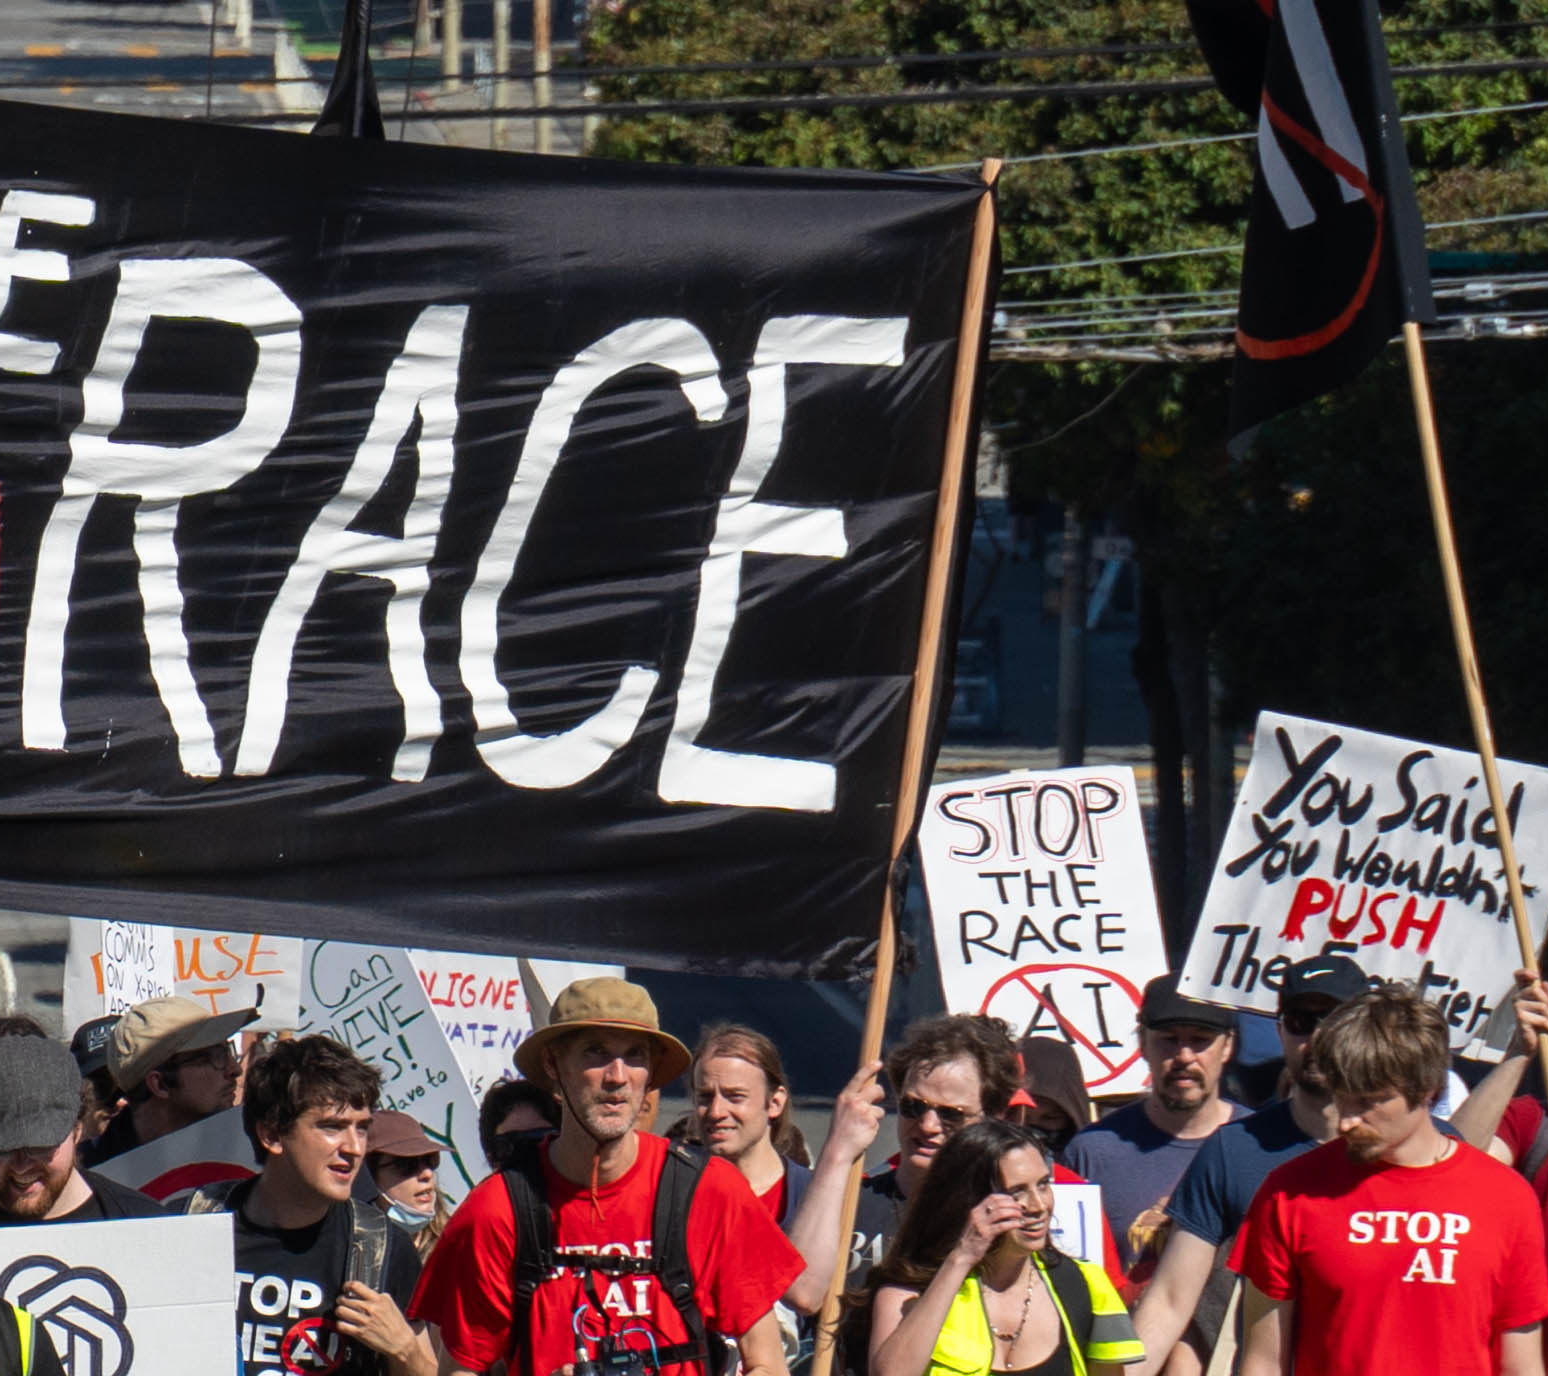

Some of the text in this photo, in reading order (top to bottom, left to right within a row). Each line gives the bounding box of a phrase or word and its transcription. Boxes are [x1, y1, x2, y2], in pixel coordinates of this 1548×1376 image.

[24, 255, 908, 814] RACE
[937, 775, 1125, 862] STOP
[1262, 726, 1524, 849] You Said
[1225, 814, 1321, 884] You
[976, 863, 1100, 909] THE
[1278, 876, 1449, 956] PUSH
[959, 911, 1127, 965] RACE
[1211, 922, 1292, 991] The
[310, 939, 393, 1009] Can
[419, 969, 530, 1012] LIGNE
[319, 983, 425, 1049] VIVE
[441, 1020, 533, 1049] ATIN
[1022, 979, 1122, 1052] AI
[1347, 1210, 1471, 1246] STOP
[235, 1271, 323, 1319] TOP
[1402, 1249, 1456, 1286] AI
